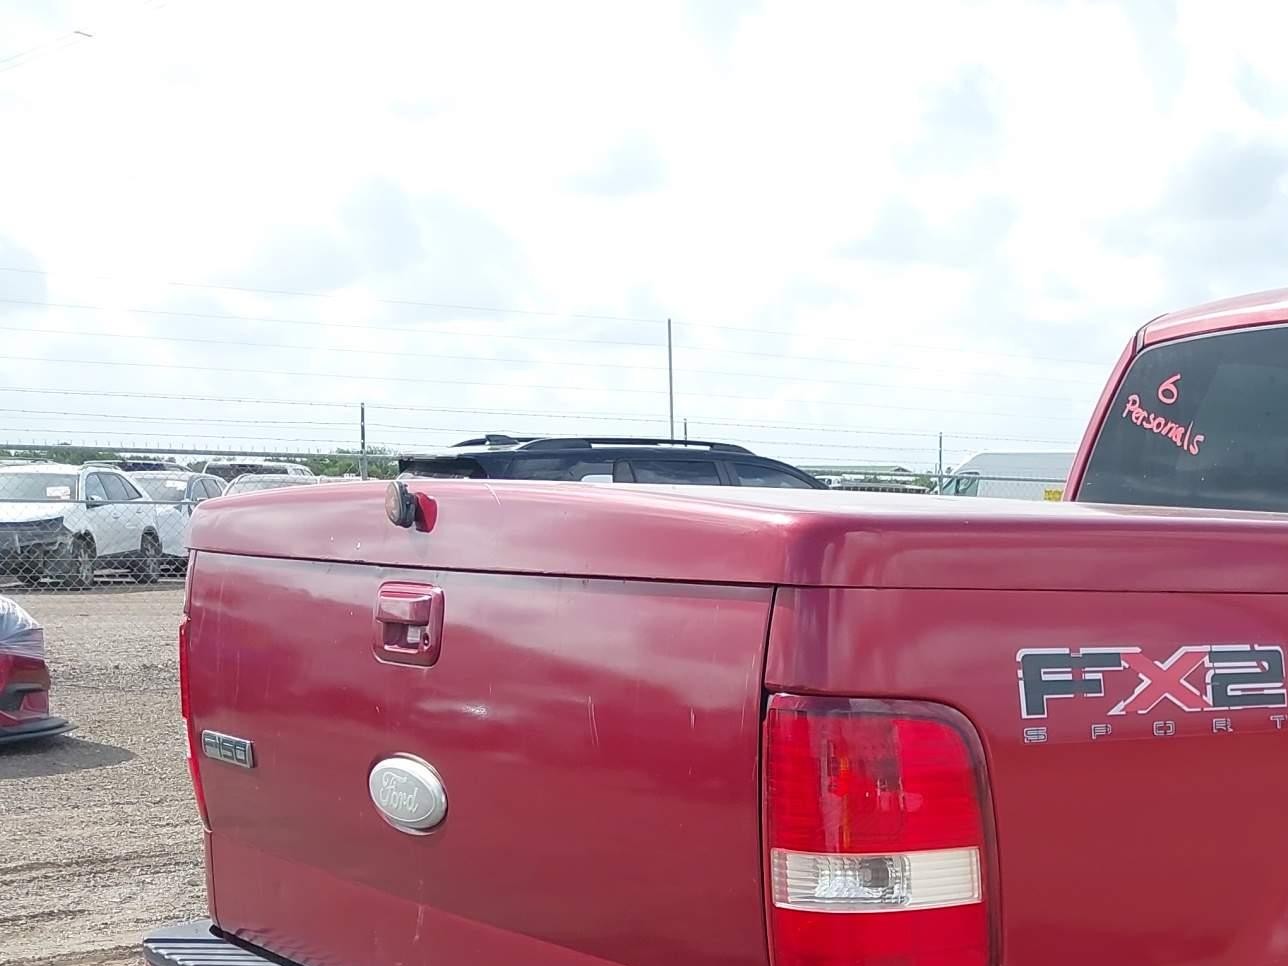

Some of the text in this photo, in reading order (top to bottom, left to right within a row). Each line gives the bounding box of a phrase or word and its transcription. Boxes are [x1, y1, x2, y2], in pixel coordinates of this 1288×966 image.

[1158, 373, 1182, 405] 6
[1016, 644, 1288, 719] FX2
[1023, 714, 1288, 744] SPORT
[379, 771, 419, 814] Ford
